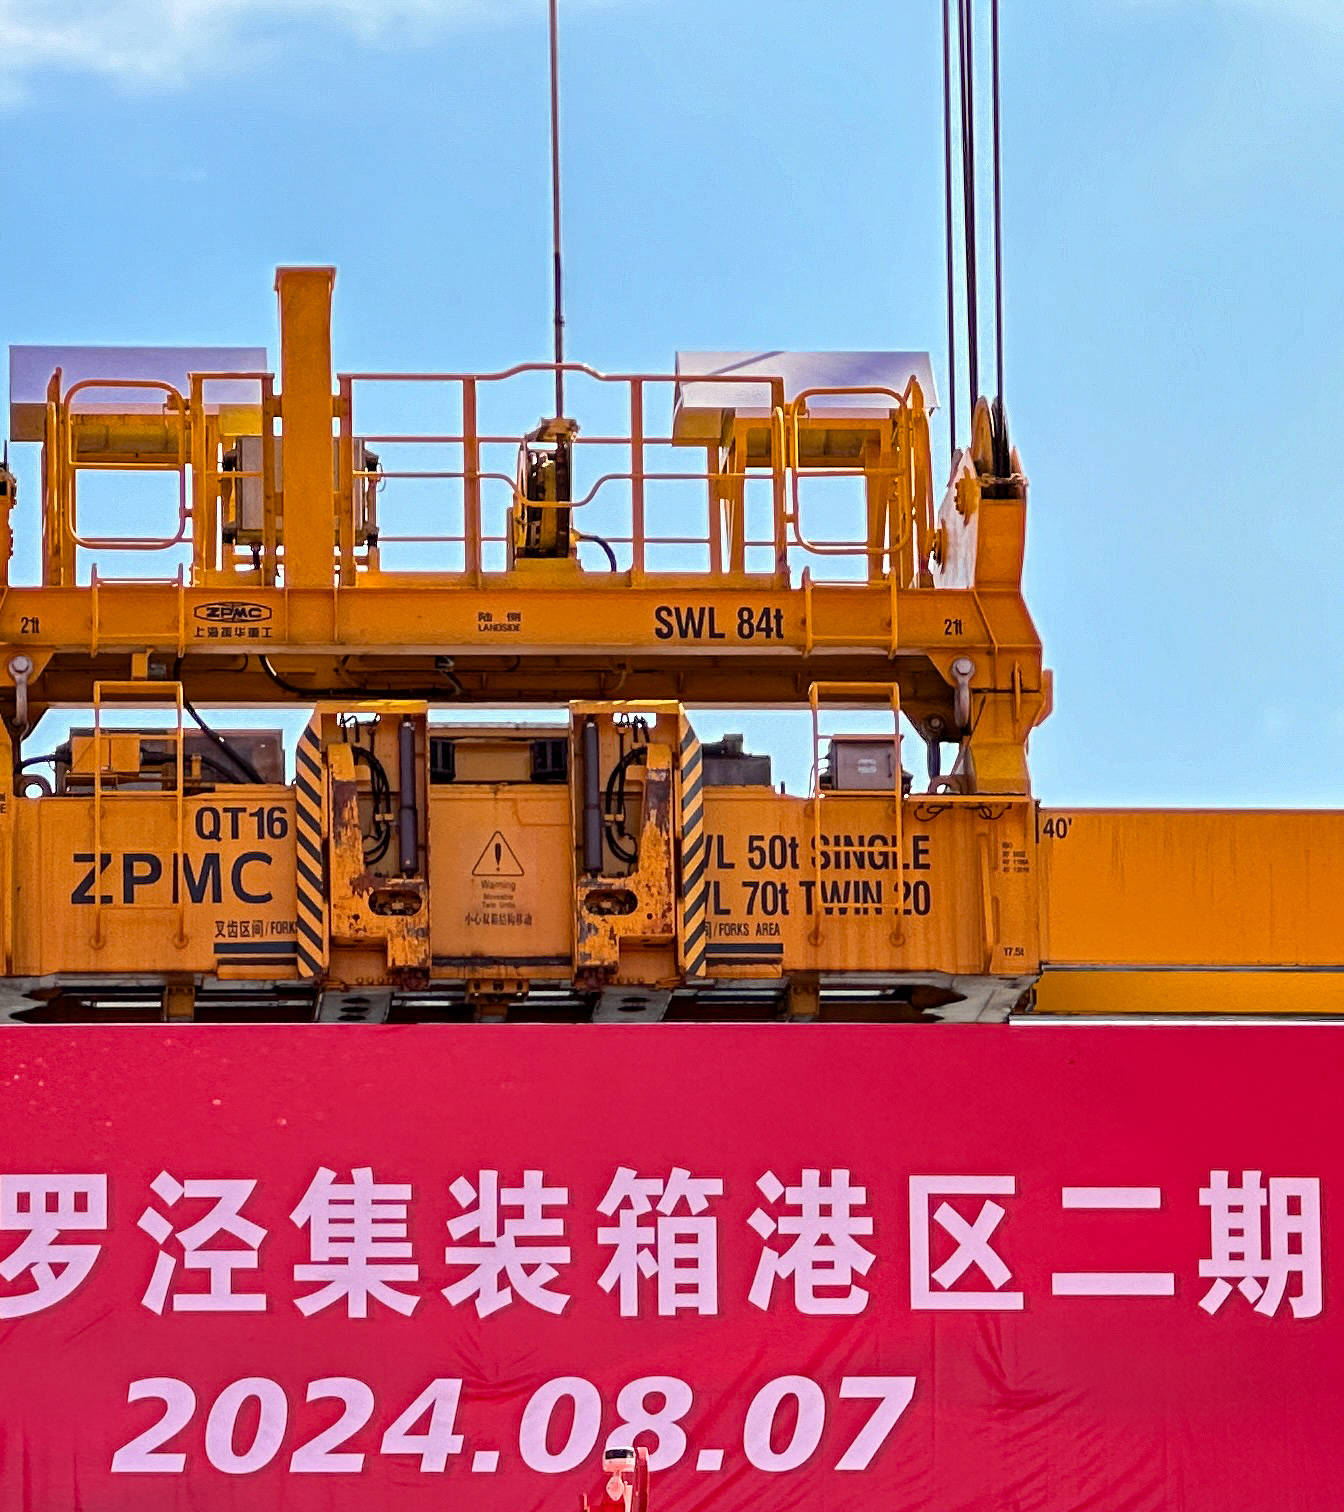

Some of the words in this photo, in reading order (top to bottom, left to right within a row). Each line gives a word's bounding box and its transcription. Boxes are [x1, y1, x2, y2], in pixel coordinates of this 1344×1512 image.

[655, 606, 726, 639] SWL
[737, 606, 784, 639] 84t
[195, 806, 289, 842] QT16
[1043, 816, 1072, 839] 40'
[748, 834, 799, 870] 50t
[811, 834, 931, 870] SINGLE
[71, 852, 273, 905] ZPMC
[742, 880, 790, 916] 70t
[799, 881, 882, 916] TWIN
[893, 880, 931, 916] 20
[755, 923, 781, 937] AREA
[111, 1375, 917, 1474] 2024.08.07
